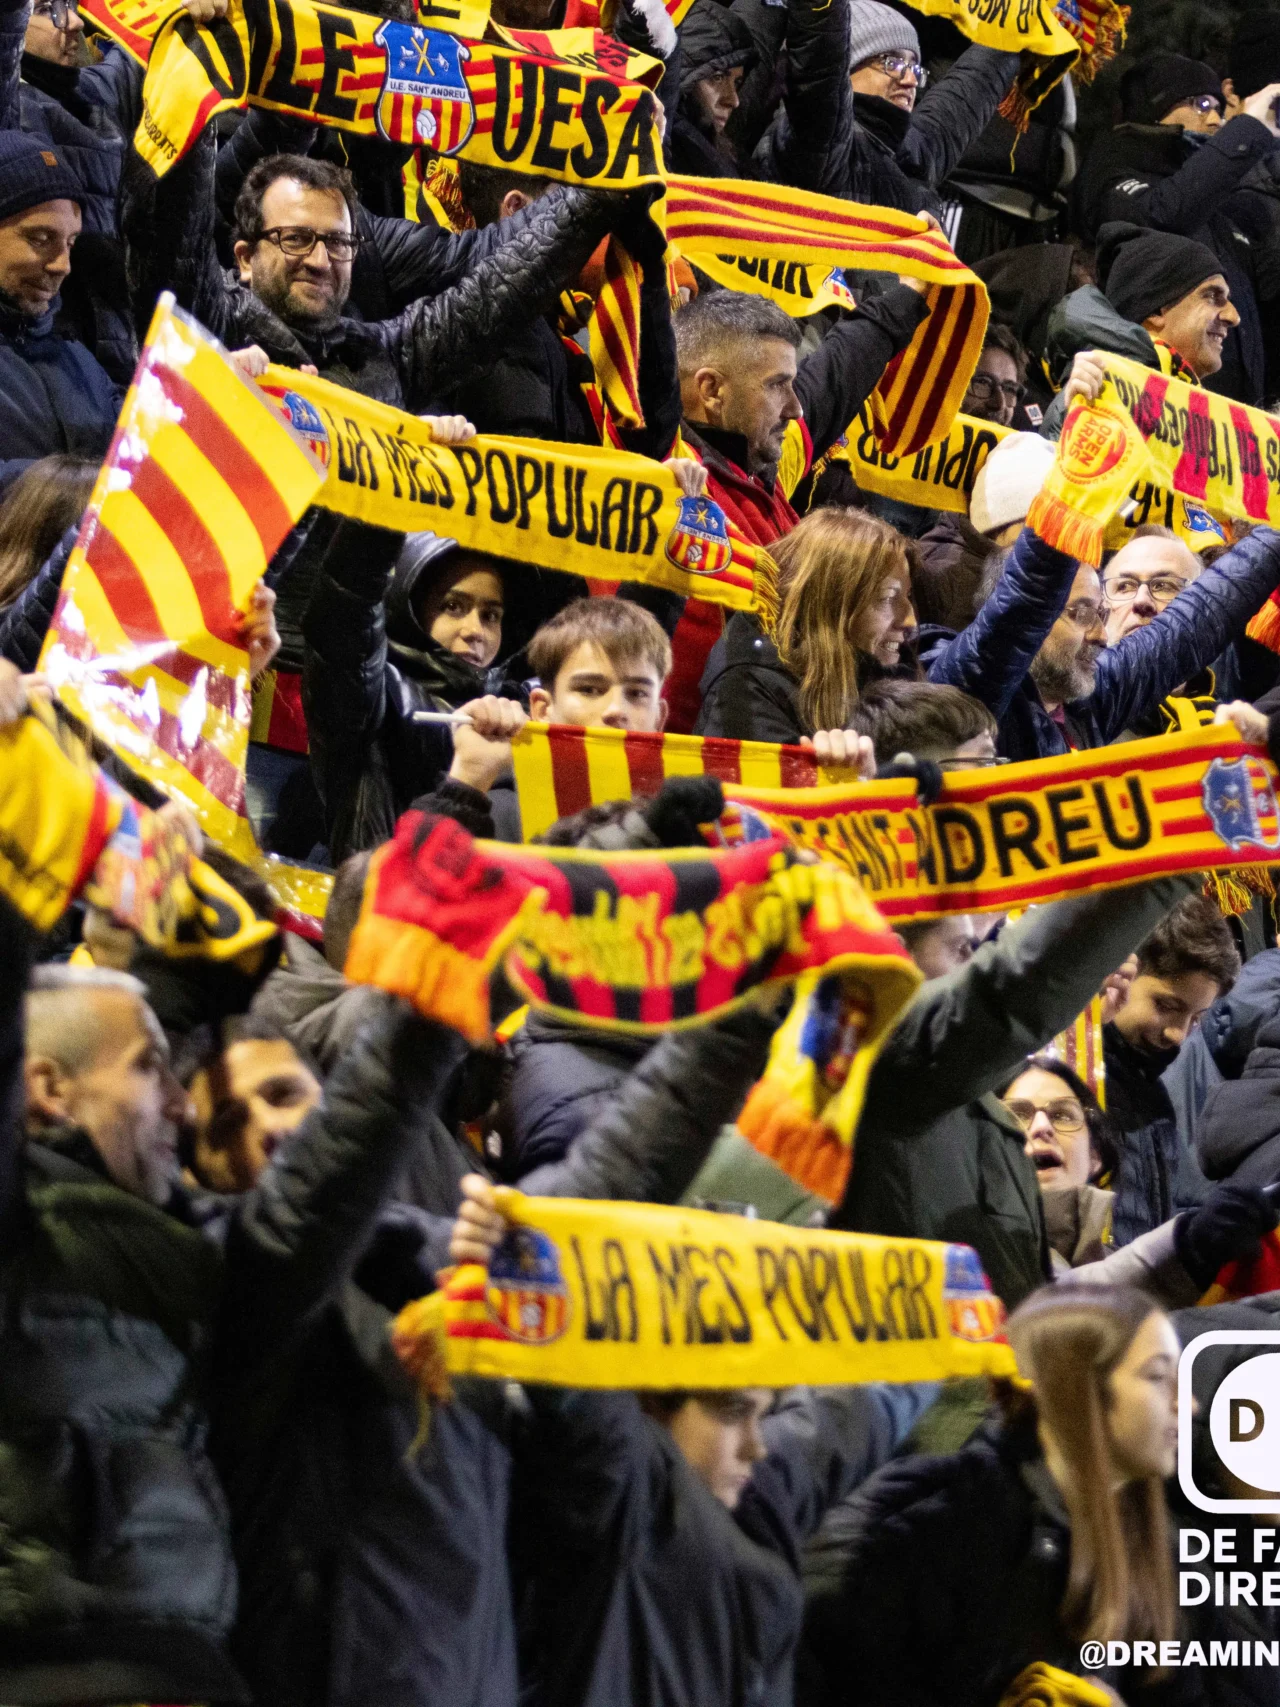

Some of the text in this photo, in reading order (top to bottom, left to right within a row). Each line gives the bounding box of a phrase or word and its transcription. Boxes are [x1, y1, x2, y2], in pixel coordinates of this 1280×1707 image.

[408, 83, 429, 94] SANT
[431, 87, 466, 99] ANDREU
[492, 54, 657, 179] UESA
[1069, 416, 1100, 459] ARMS
[1079, 425, 1112, 467] OPEN
[321, 407, 663, 556] LA MÉS POPULAR
[570, 1234, 638, 1342] LA
[754, 1245, 938, 1342] POPULAR
